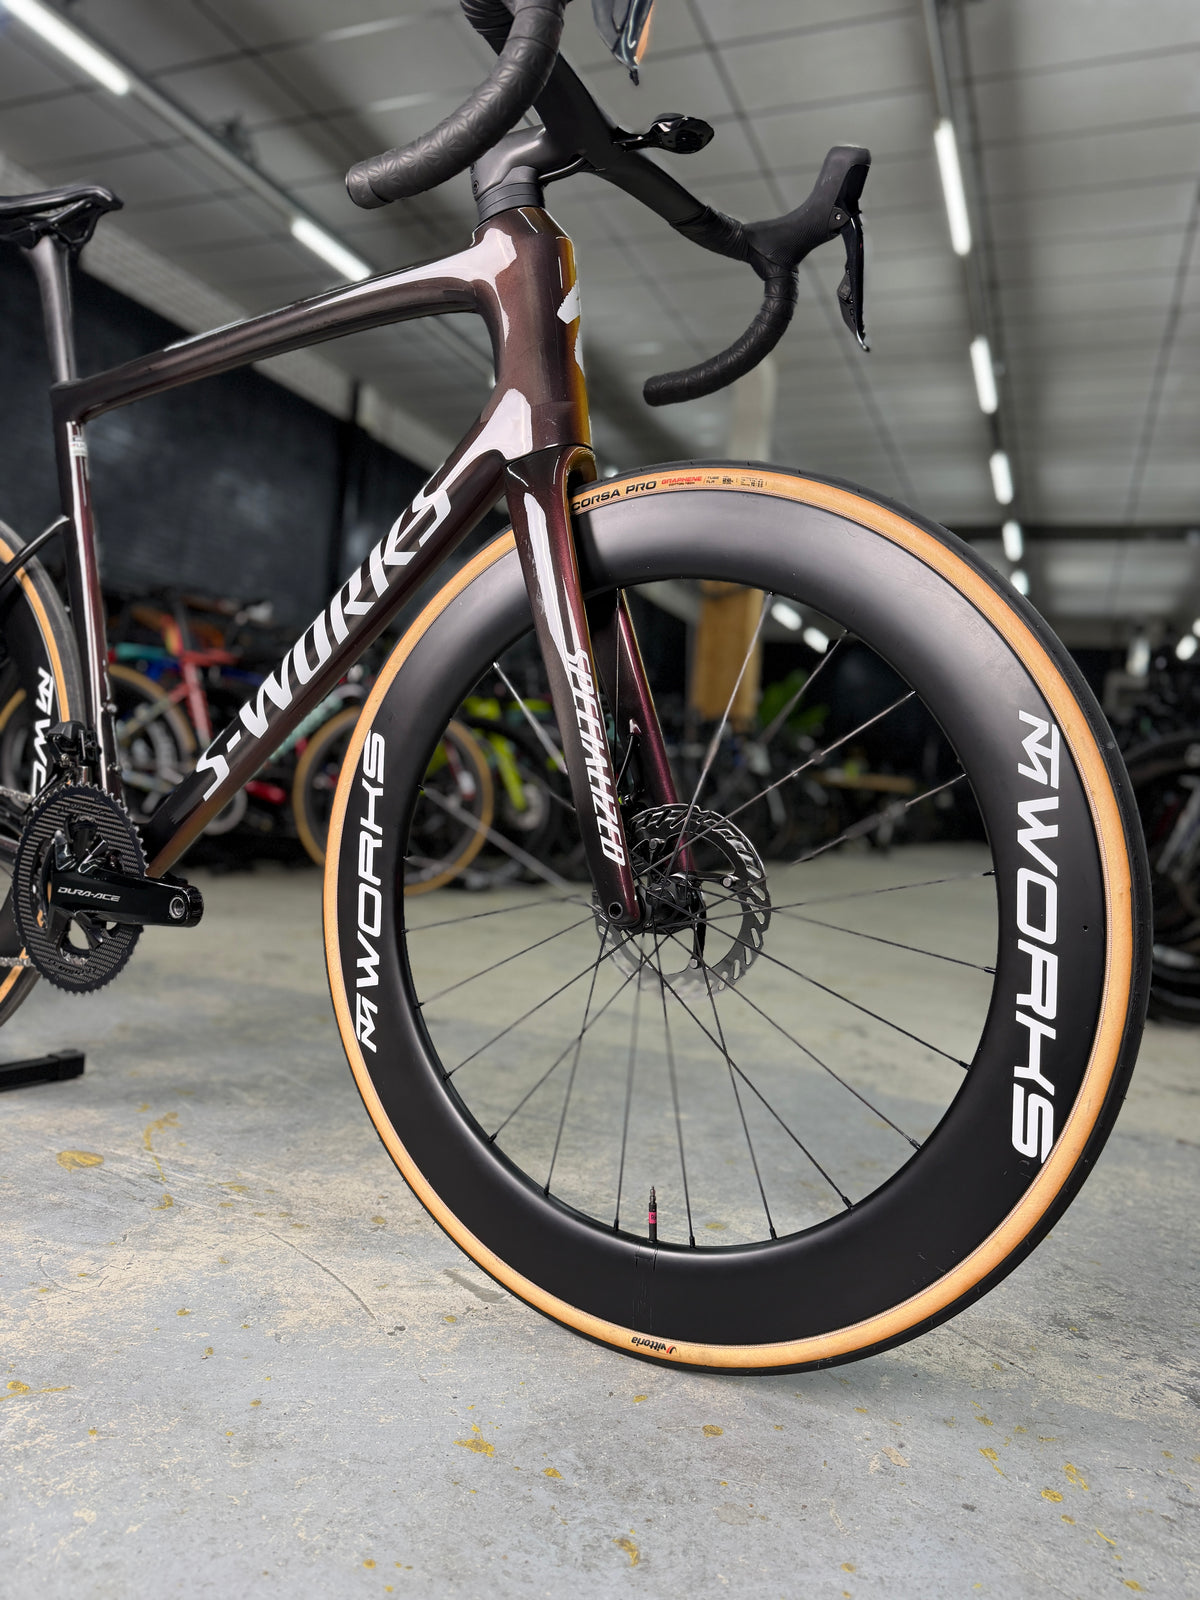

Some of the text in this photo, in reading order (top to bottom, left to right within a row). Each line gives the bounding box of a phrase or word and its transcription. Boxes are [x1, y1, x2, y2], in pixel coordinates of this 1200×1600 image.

[661, 476, 702, 485] GRAPHENE
[571, 481, 657, 511] CORSA PRO
[196, 488, 452, 802] S-WORKS
[567, 647, 626, 867] SPECIALIZED
[57, 886, 121, 902] DURA-ACE
[631, 1336, 667, 1352] vittoria
